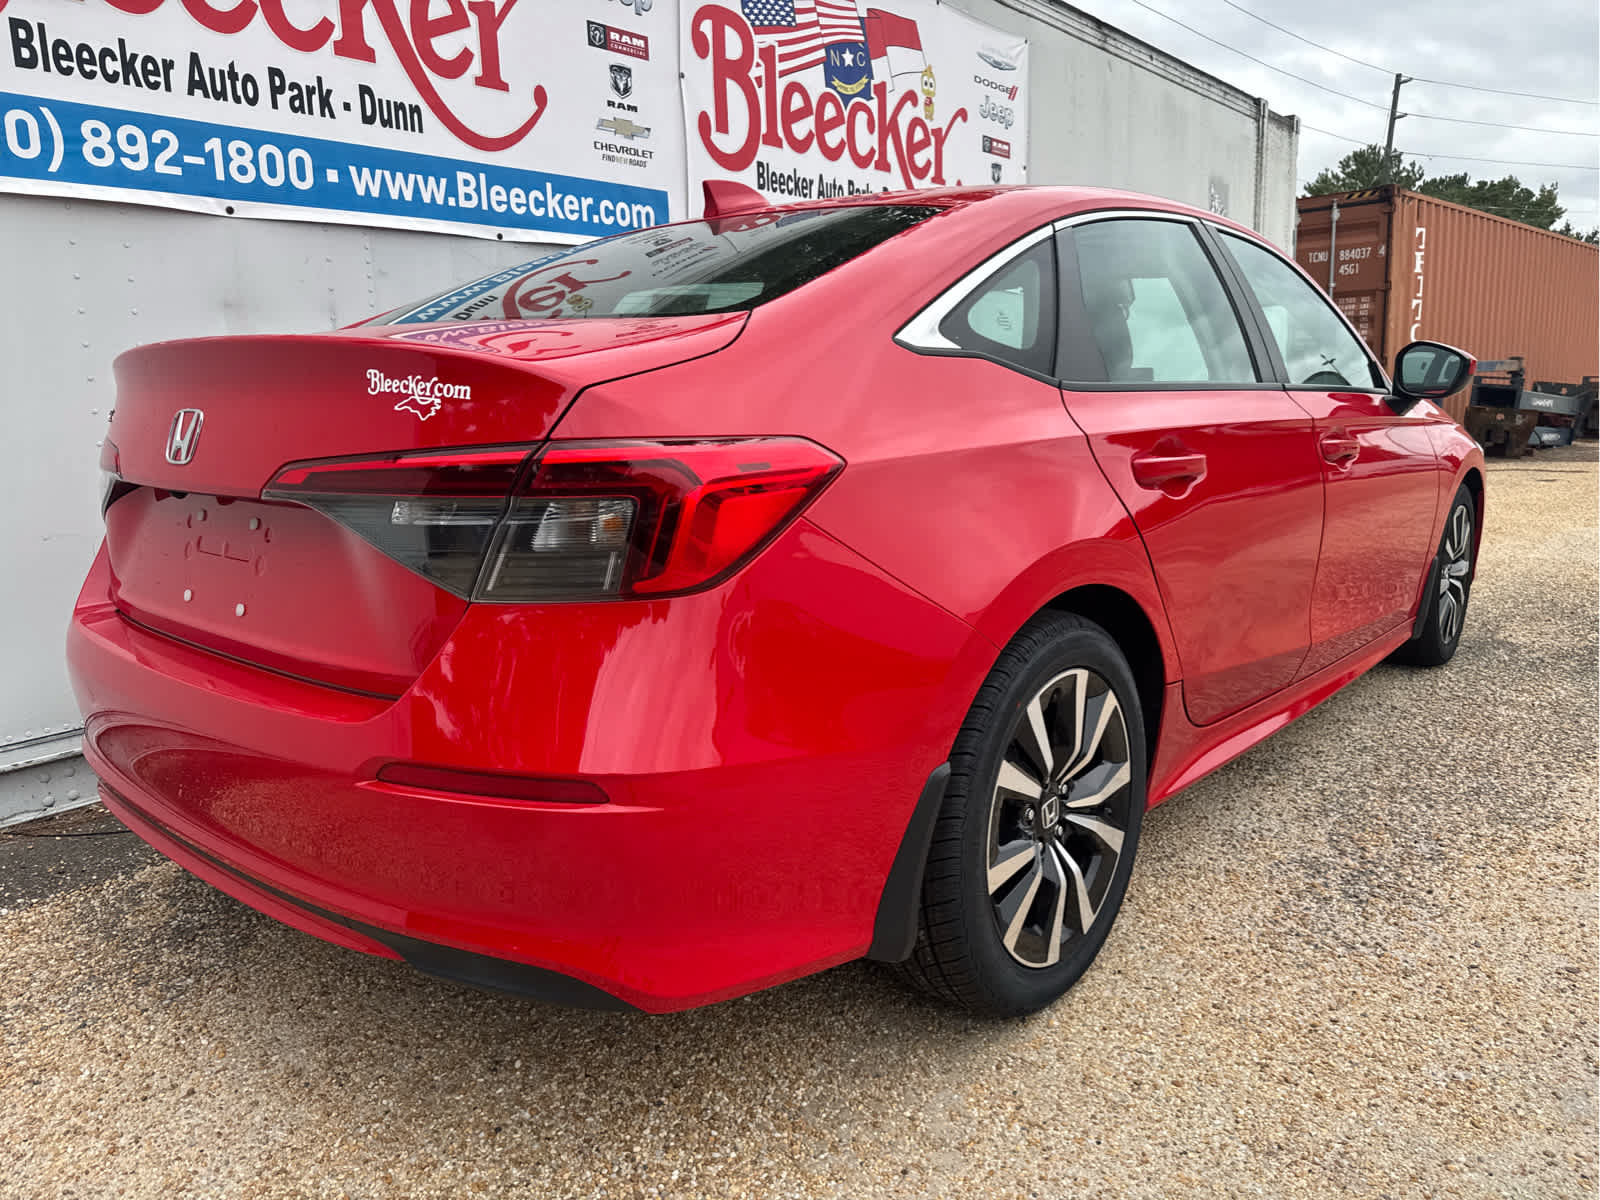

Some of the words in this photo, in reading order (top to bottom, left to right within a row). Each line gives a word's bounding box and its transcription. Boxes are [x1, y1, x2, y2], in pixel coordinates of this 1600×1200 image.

[610, 31, 645, 48] RAM
[830, 49, 840, 67] N
[857, 51, 866, 67] C
[8, 16, 174, 92] Bleecker
[187, 52, 259, 107] Auto
[268, 66, 336, 119] Park
[358, 83, 423, 133] Dunn
[974, 75, 1011, 94] DODGE
[607, 100, 638, 112] RAM
[692, 4, 968, 189] Bleecker
[979, 94, 1014, 130] Jeep
[593, 141, 655, 160] CHEVROLET
[80, 119, 314, 190] 892-1800
[348, 165, 656, 229] www.Bleecker.com
[756, 161, 814, 199] Bleecker
[818, 174, 844, 199] Auto
[1308, 251, 1329, 263] TCNU
[1339, 247, 1371, 261] 884037
[1339, 263, 1359, 275] 45G1
